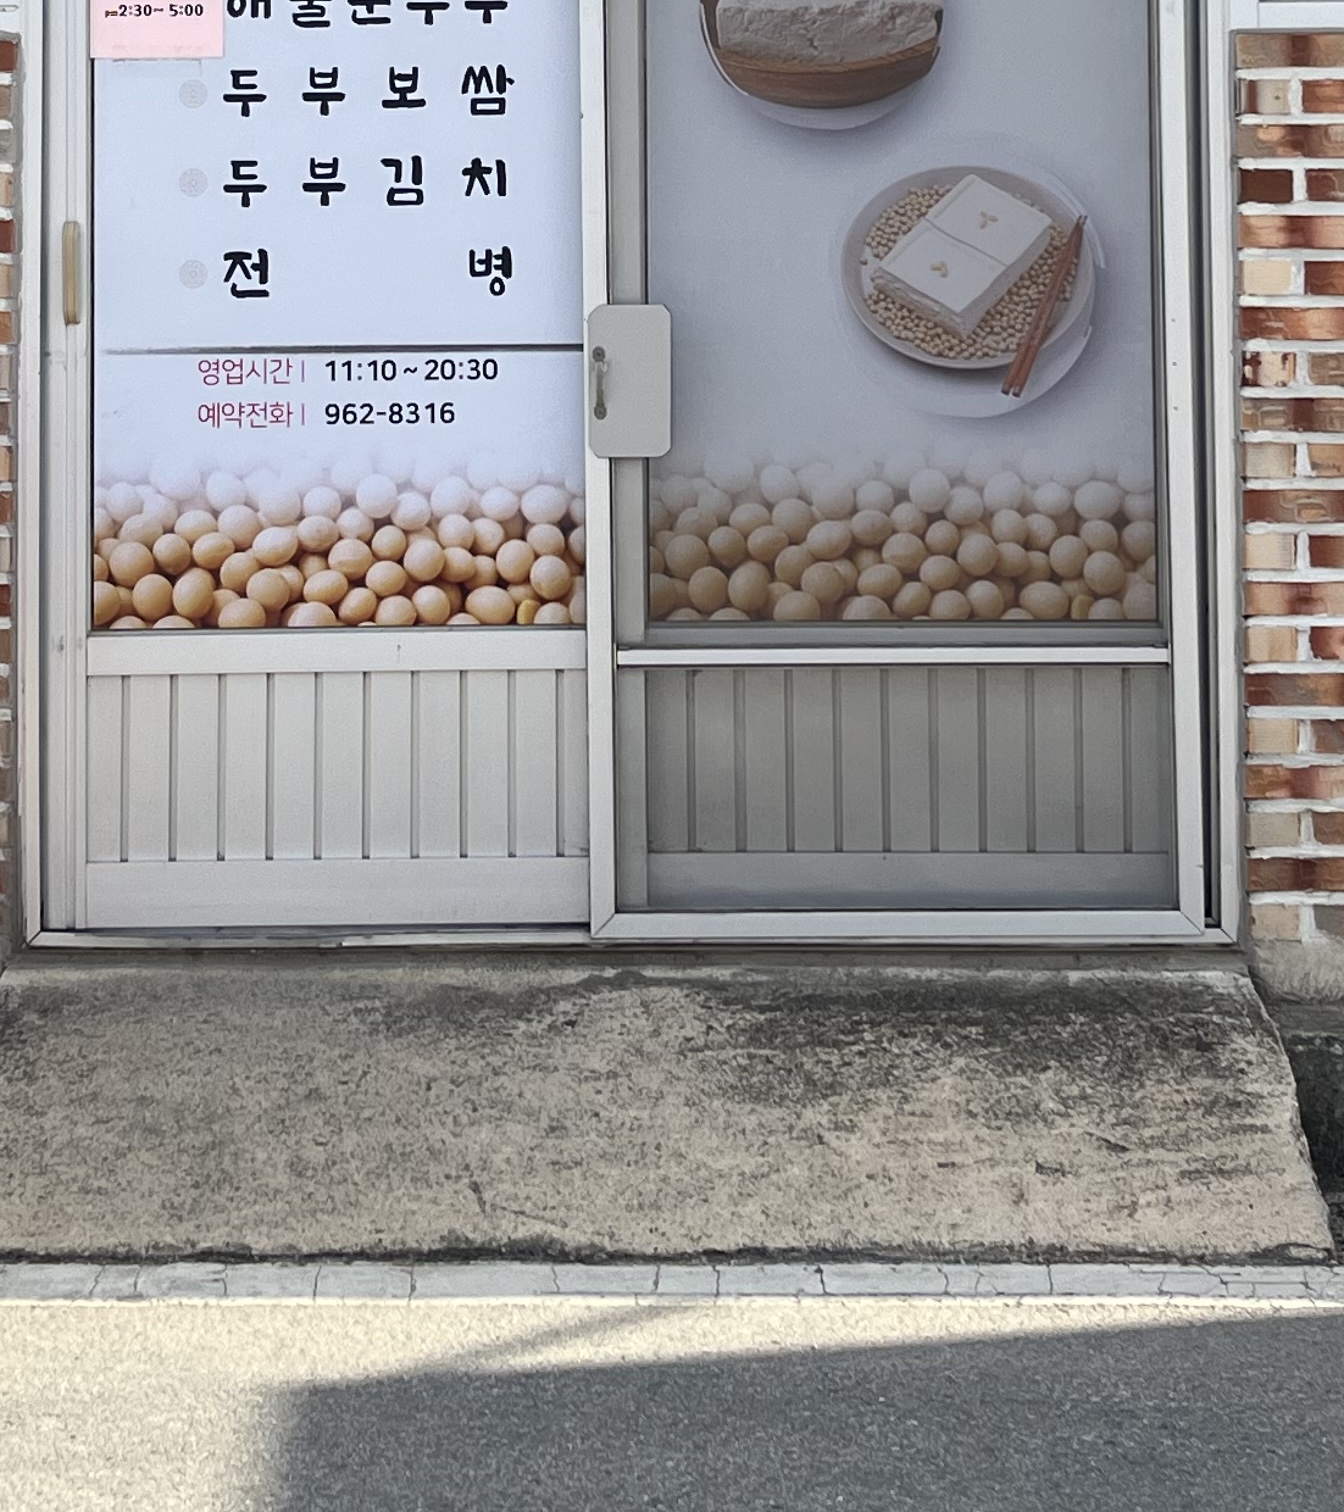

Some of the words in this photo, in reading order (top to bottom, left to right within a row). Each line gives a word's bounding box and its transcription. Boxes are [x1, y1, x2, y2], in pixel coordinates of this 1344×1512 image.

[197, 357, 293, 386] 영업시간
[197, 401, 293, 429] 예약전화
[324, 401, 455, 425] 962-8316
